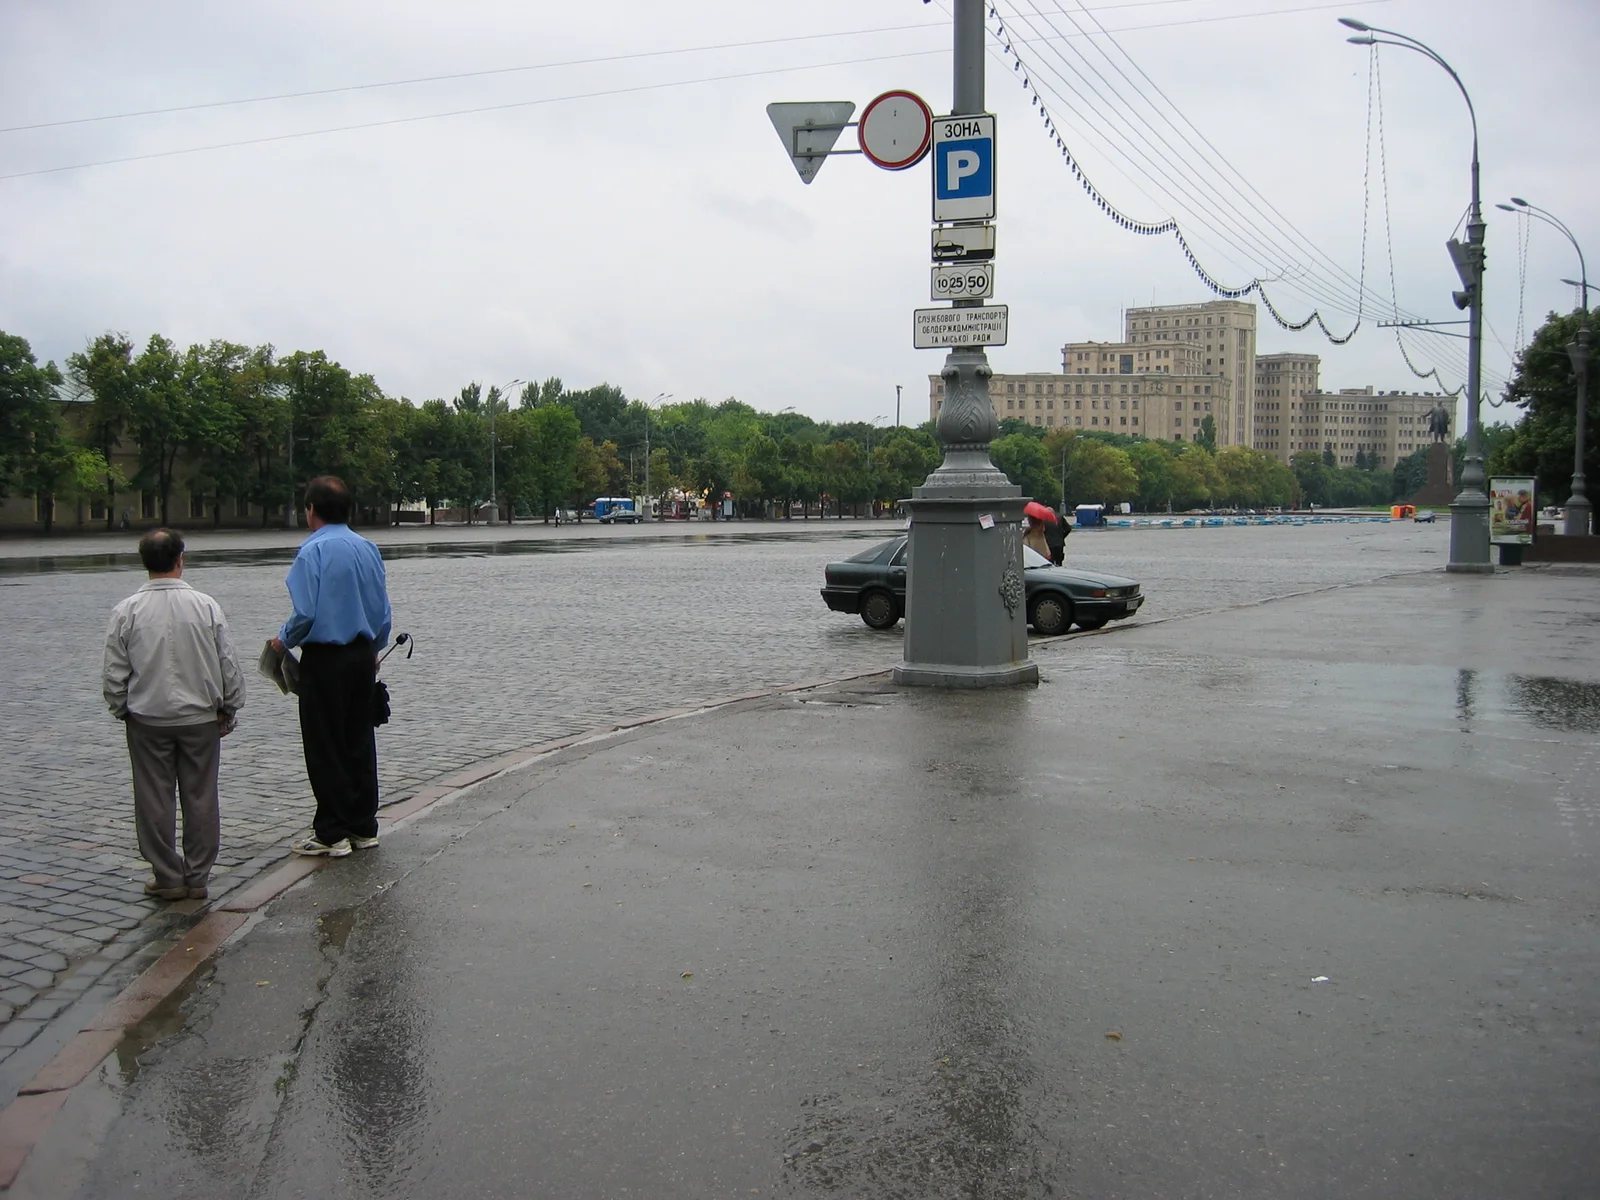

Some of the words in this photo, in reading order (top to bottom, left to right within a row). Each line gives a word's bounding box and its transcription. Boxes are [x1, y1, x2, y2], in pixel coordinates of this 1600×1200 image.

[945, 122, 981, 138] ЗОНА
[947, 150, 980, 191] P
[937, 279, 949, 288] 10
[950, 277, 963, 288] 25
[968, 276, 985, 288] 50
[917, 314, 960, 323] СЛУЖБОВОГО
[966, 312, 1006, 321] ТРАНСПОРТУ
[931, 336, 939, 344] ТА
[972, 333, 991, 342] РАДИ
